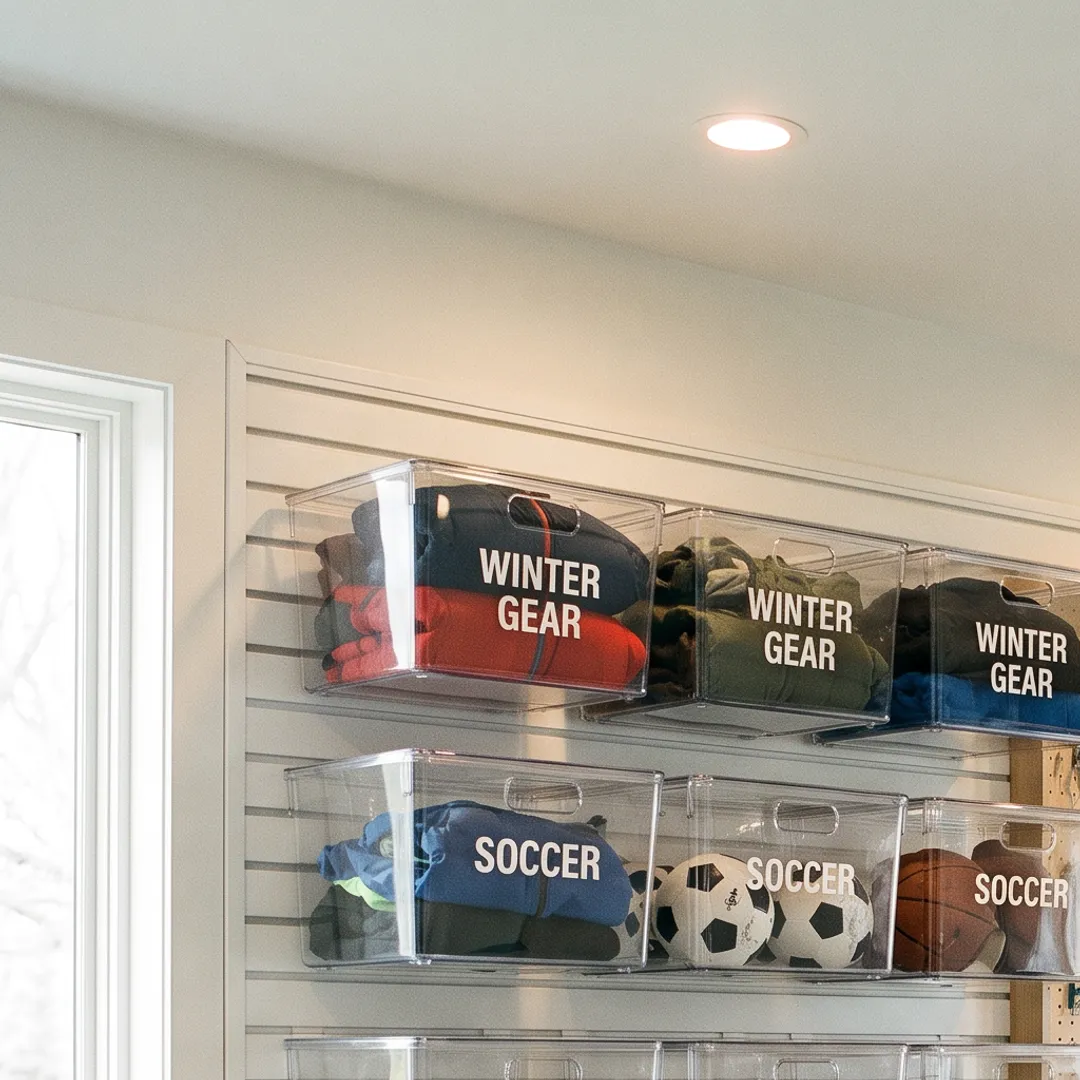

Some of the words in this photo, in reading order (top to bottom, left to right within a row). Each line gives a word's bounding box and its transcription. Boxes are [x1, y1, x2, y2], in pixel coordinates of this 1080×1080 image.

[480, 548, 600, 599] WINTER
[498, 596, 581, 639] GEAR
[747, 587, 852, 633] WINTER
[764, 630, 836, 671] GEAR
[976, 620, 1068, 663] WINTER
[990, 662, 1053, 699] GEAR
[474, 836, 600, 881] SOCCER
[745, 857, 855, 895] SOCCER
[975, 873, 1069, 908] SOCCER
